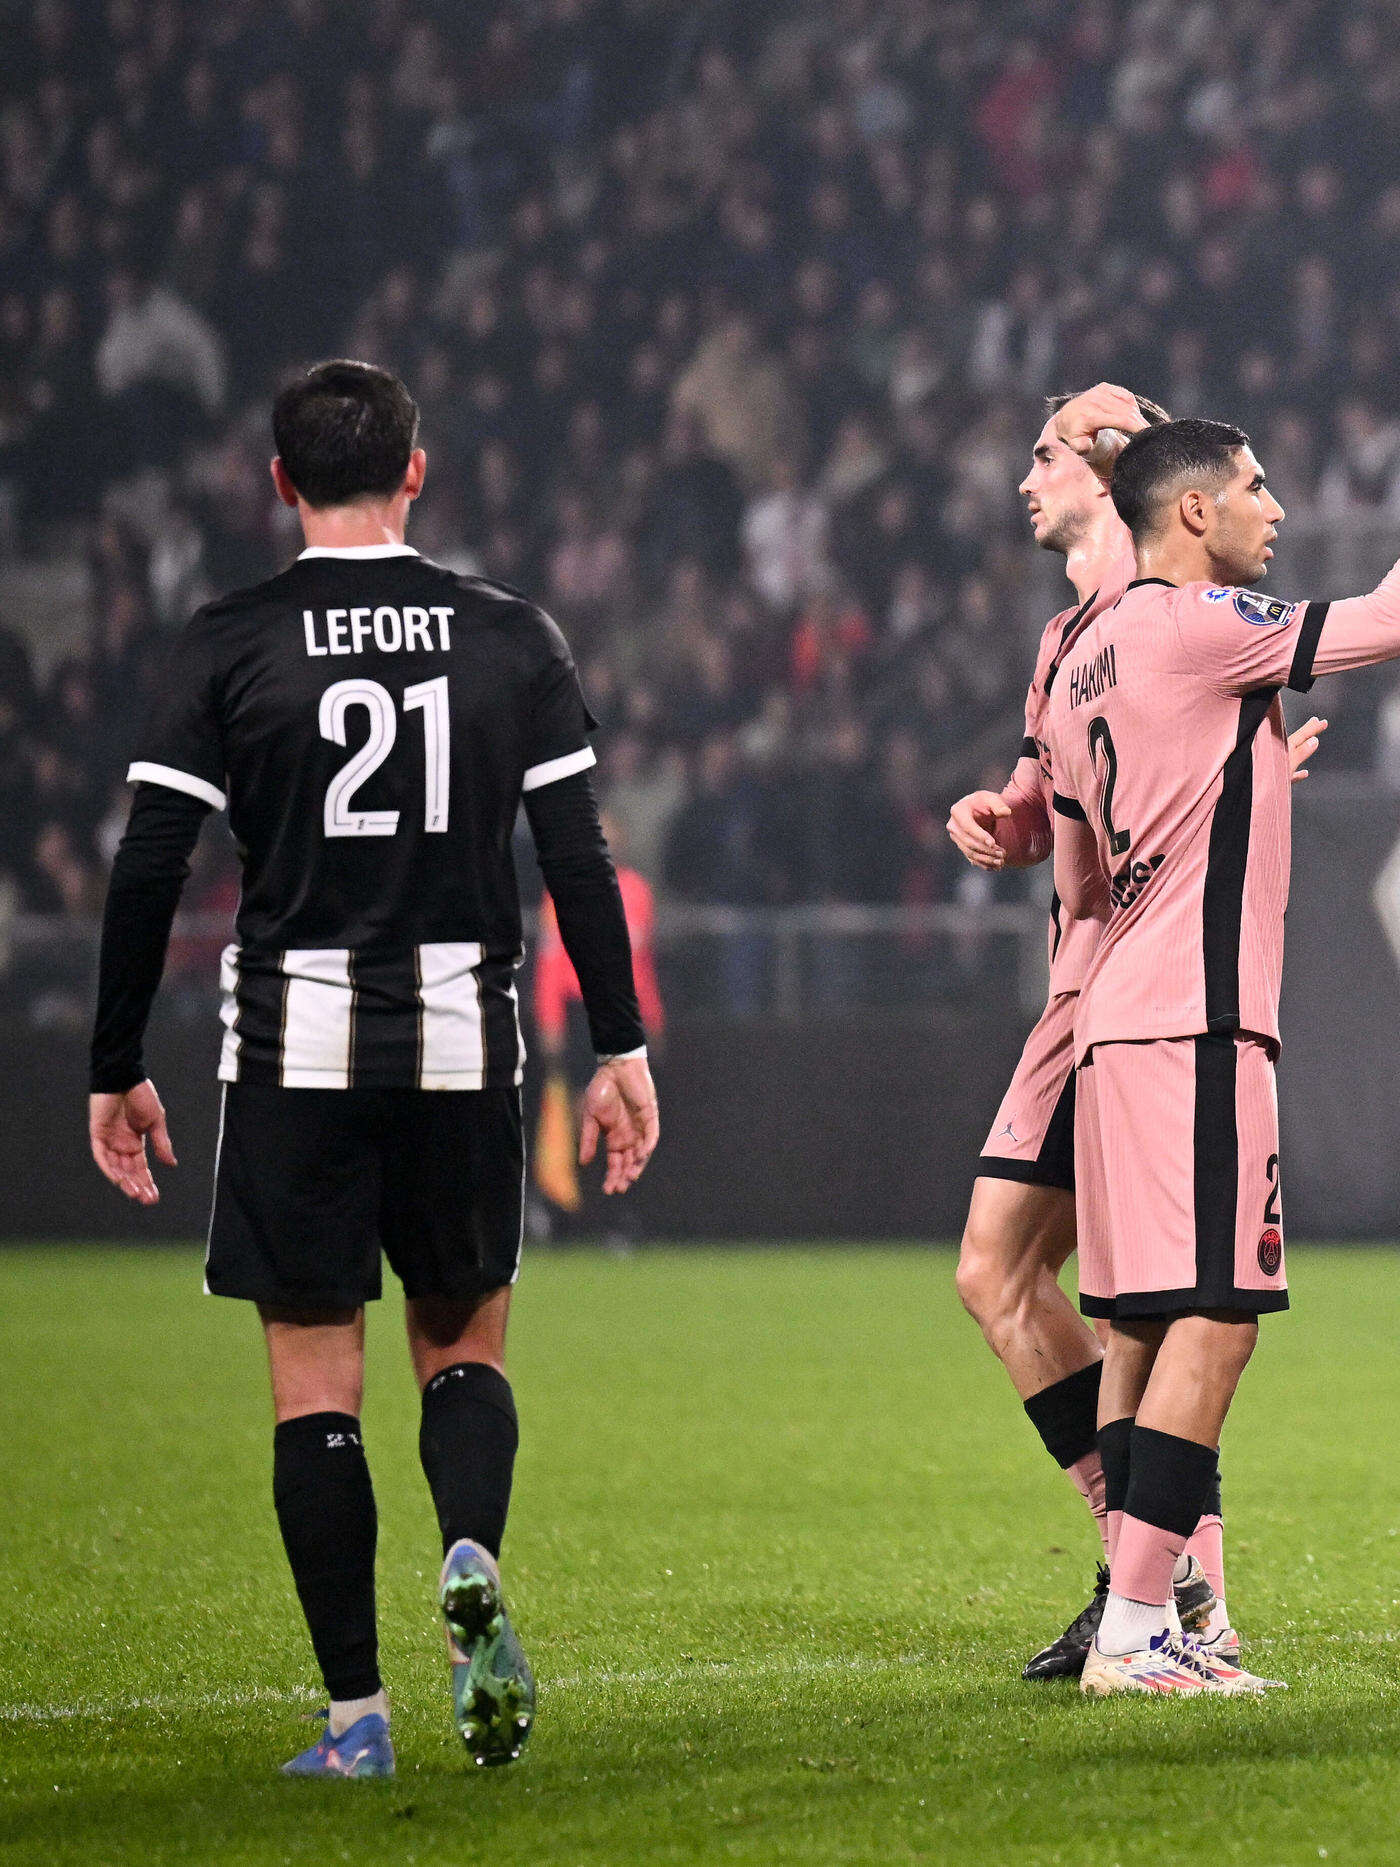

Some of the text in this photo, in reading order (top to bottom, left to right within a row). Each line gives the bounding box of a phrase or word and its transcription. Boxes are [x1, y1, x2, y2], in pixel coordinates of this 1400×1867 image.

[303, 605, 455, 657] LEFORT
[1070, 644, 1117, 710] HAKIMI
[319, 675, 451, 838] 21
[1087, 716, 1131, 857] 2
[1264, 1153, 1280, 1225] 2
